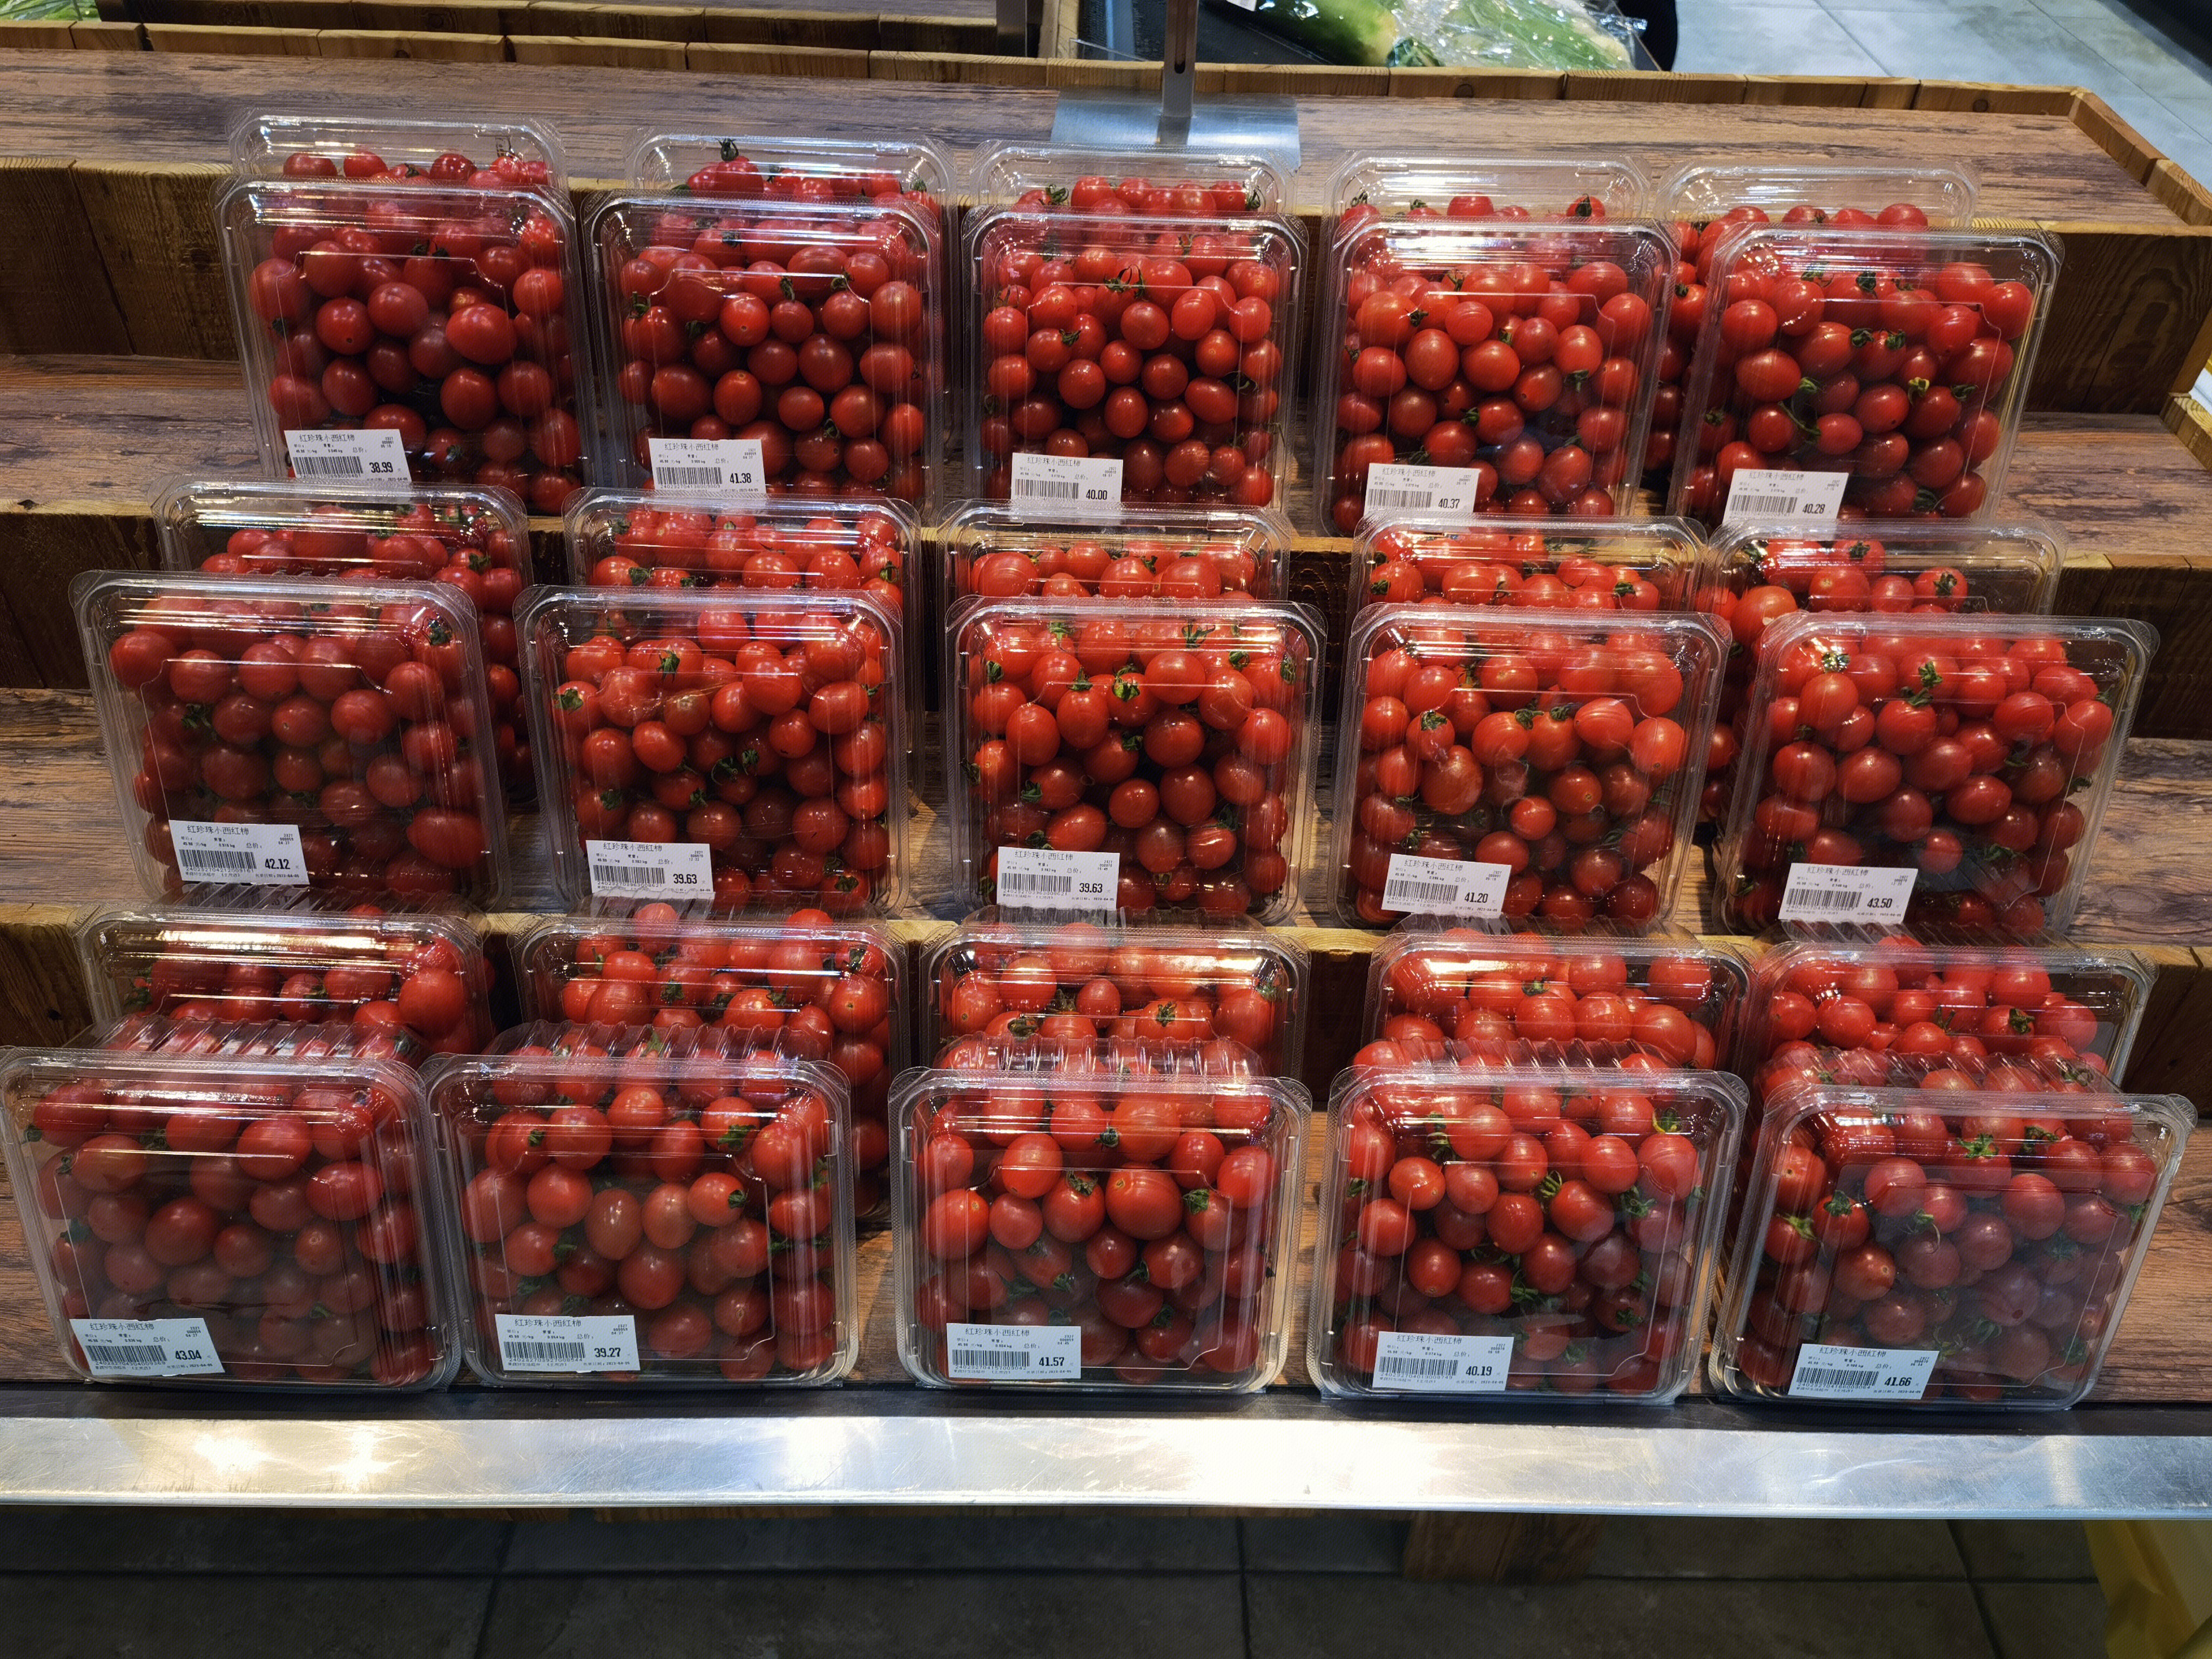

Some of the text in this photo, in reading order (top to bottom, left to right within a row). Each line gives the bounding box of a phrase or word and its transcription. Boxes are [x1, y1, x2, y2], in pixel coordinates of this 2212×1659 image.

[299, 433, 355, 442] 红珍珠小西红柿
[664, 442, 719, 451] 红珍珠小西红柿
[369, 461, 394, 473] 38.99
[1027, 456, 1081, 467] 红珍珠小西红柿
[1382, 467, 1436, 477] 红珍珠小西红柿
[730, 473, 752, 484] 41.38
[1085, 489, 1108, 501] 40.00
[1438, 498, 1460, 509] 40.37
[1802, 503, 1826, 514] 40.28
[186, 825, 249, 835] 红珍珠小西红柿
[603, 842, 662, 852] 红珍珠小西红柿
[1015, 850, 1073, 861] 红珍珠小西红柿
[265, 858, 291, 870] 42.12
[1404, 859, 1464, 871] 红珍珠小西红柿
[1807, 866, 1869, 876] 红珍珠小西红柿
[673, 873, 698, 885] 39.63
[1079, 882, 1103, 893] 39.63
[1464, 892, 1489, 903] 41.20
[1867, 898, 1893, 908] 43.50
[89, 1323, 154, 1331] 红珍珠小西红柿
[515, 1318, 582, 1327] 红珍珠小西红柿
[965, 1327, 1030, 1337] 红珍珠小西红柿
[1397, 1334, 1462, 1345] 红珍珠小西红柿
[175, 1350, 202, 1360] 43.04
[594, 1347, 621, 1358] 39.27
[1819, 1346, 1887, 1358] 红珍珠小西红柿
[1038, 1357, 1065, 1366] 41.57
[1465, 1366, 1493, 1376] 40.19
[1884, 1377, 1912, 1386] 41.66
